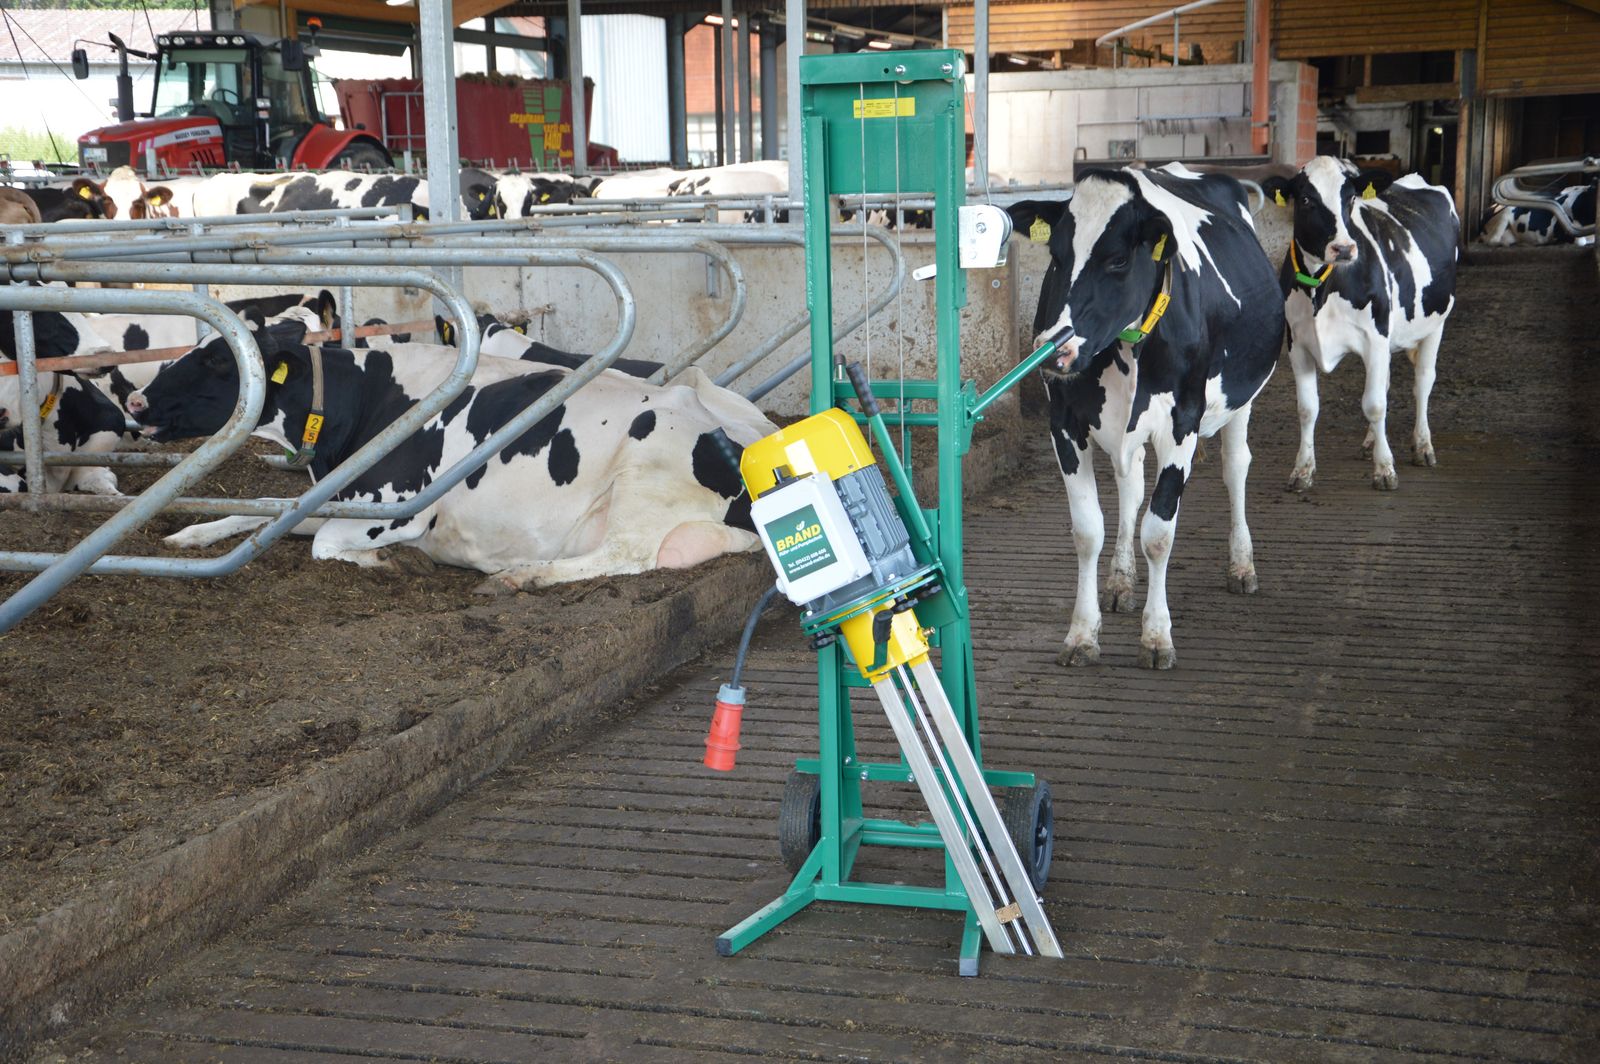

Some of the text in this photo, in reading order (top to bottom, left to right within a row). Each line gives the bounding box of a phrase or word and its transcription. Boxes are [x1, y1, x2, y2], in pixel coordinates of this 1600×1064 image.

[1158, 298, 1167, 313] 2
[307, 417, 319, 441] 2 5
[776, 524, 821, 552] BRAND
